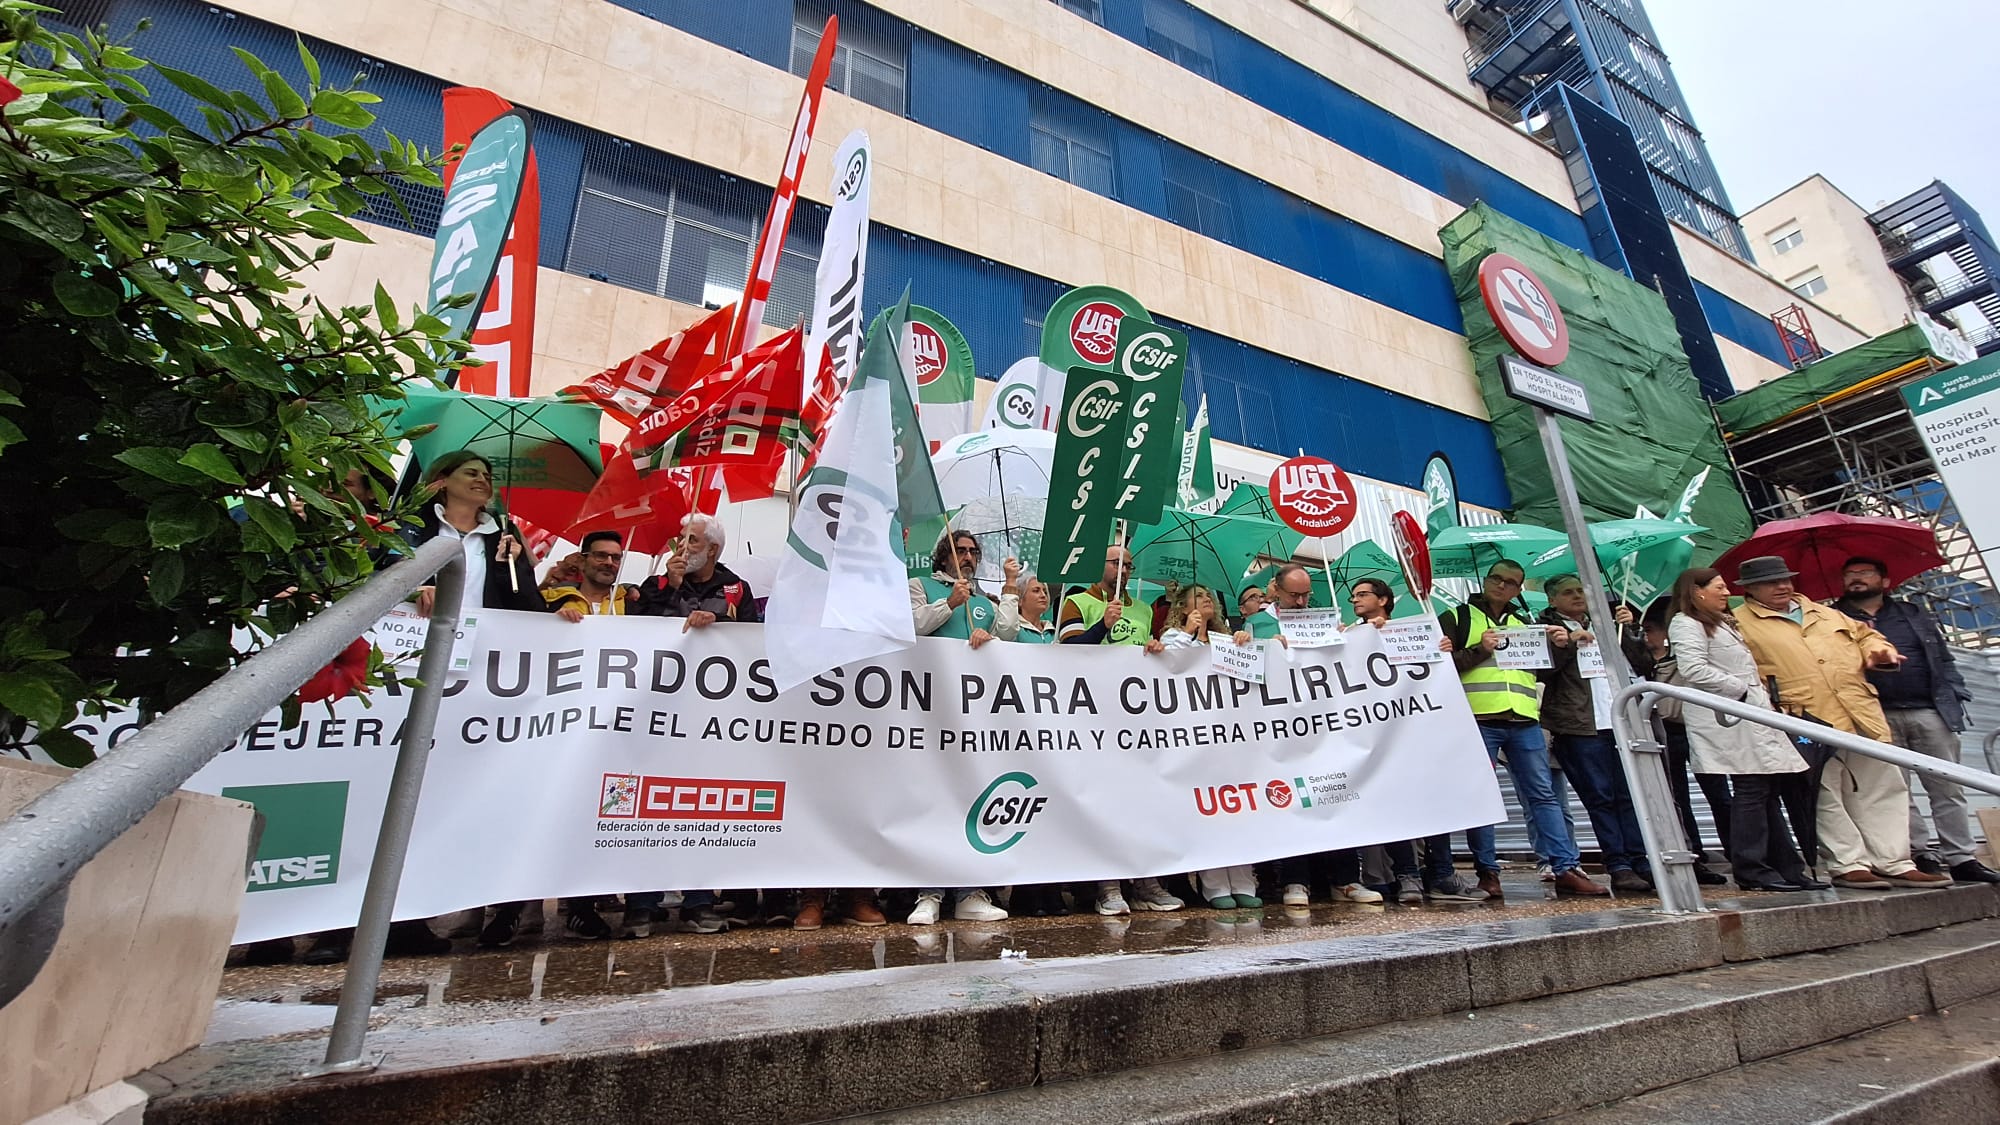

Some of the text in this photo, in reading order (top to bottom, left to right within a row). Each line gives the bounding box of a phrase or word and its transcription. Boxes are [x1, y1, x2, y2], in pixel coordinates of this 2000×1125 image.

[1133, 345, 1178, 370] CSIF
[1512, 366, 1583, 398] EN TODO EL RECINTO
[1942, 375, 1970, 389] Junta
[1944, 387, 1958, 395] de
[1526, 382, 1576, 405] HOSPITALARIO
[1079, 396, 1124, 421] CSIF
[1925, 406, 1990, 434] Hospital
[1935, 436, 1987, 456] Puerta
[1941, 444, 1998, 467] del Mar
[1279, 464, 1339, 494] UGT
[382, 622, 424, 636] NO AL
[1408, 634, 1430, 642] ROBO
[395, 638, 420, 650] DEL
[1215, 645, 1258, 661] NO AL ROBO
[1223, 656, 1235, 666] DEL
[1236, 660, 1250, 669] CRP
[810, 665, 933, 712] SON
[961, 674, 1098, 715] PARA
[461, 706, 635, 745] CUMPLE
[649, 710, 687, 738] EL
[701, 716, 872, 748] ACUERDO
[887, 726, 925, 750] DE
[940, 729, 1081, 753] PRIMARIA
[1091, 729, 1105, 750] Y
[1117, 722, 1246, 750] CARRERA
[1254, 693, 1443, 741] PROFESIONAL
[1308, 771, 1347, 784] Servicios
[646, 785, 751, 812] CCOO
[1312, 783, 1347, 794] Públicos
[1317, 790, 1361, 806] Andalucía
[1193, 783, 1258, 816] UGT
[982, 796, 1048, 826] CSIF
[596, 820, 782, 835] federación de sanidad y sectores
[594, 836, 757, 848] sociosanitarios de Andalucía
